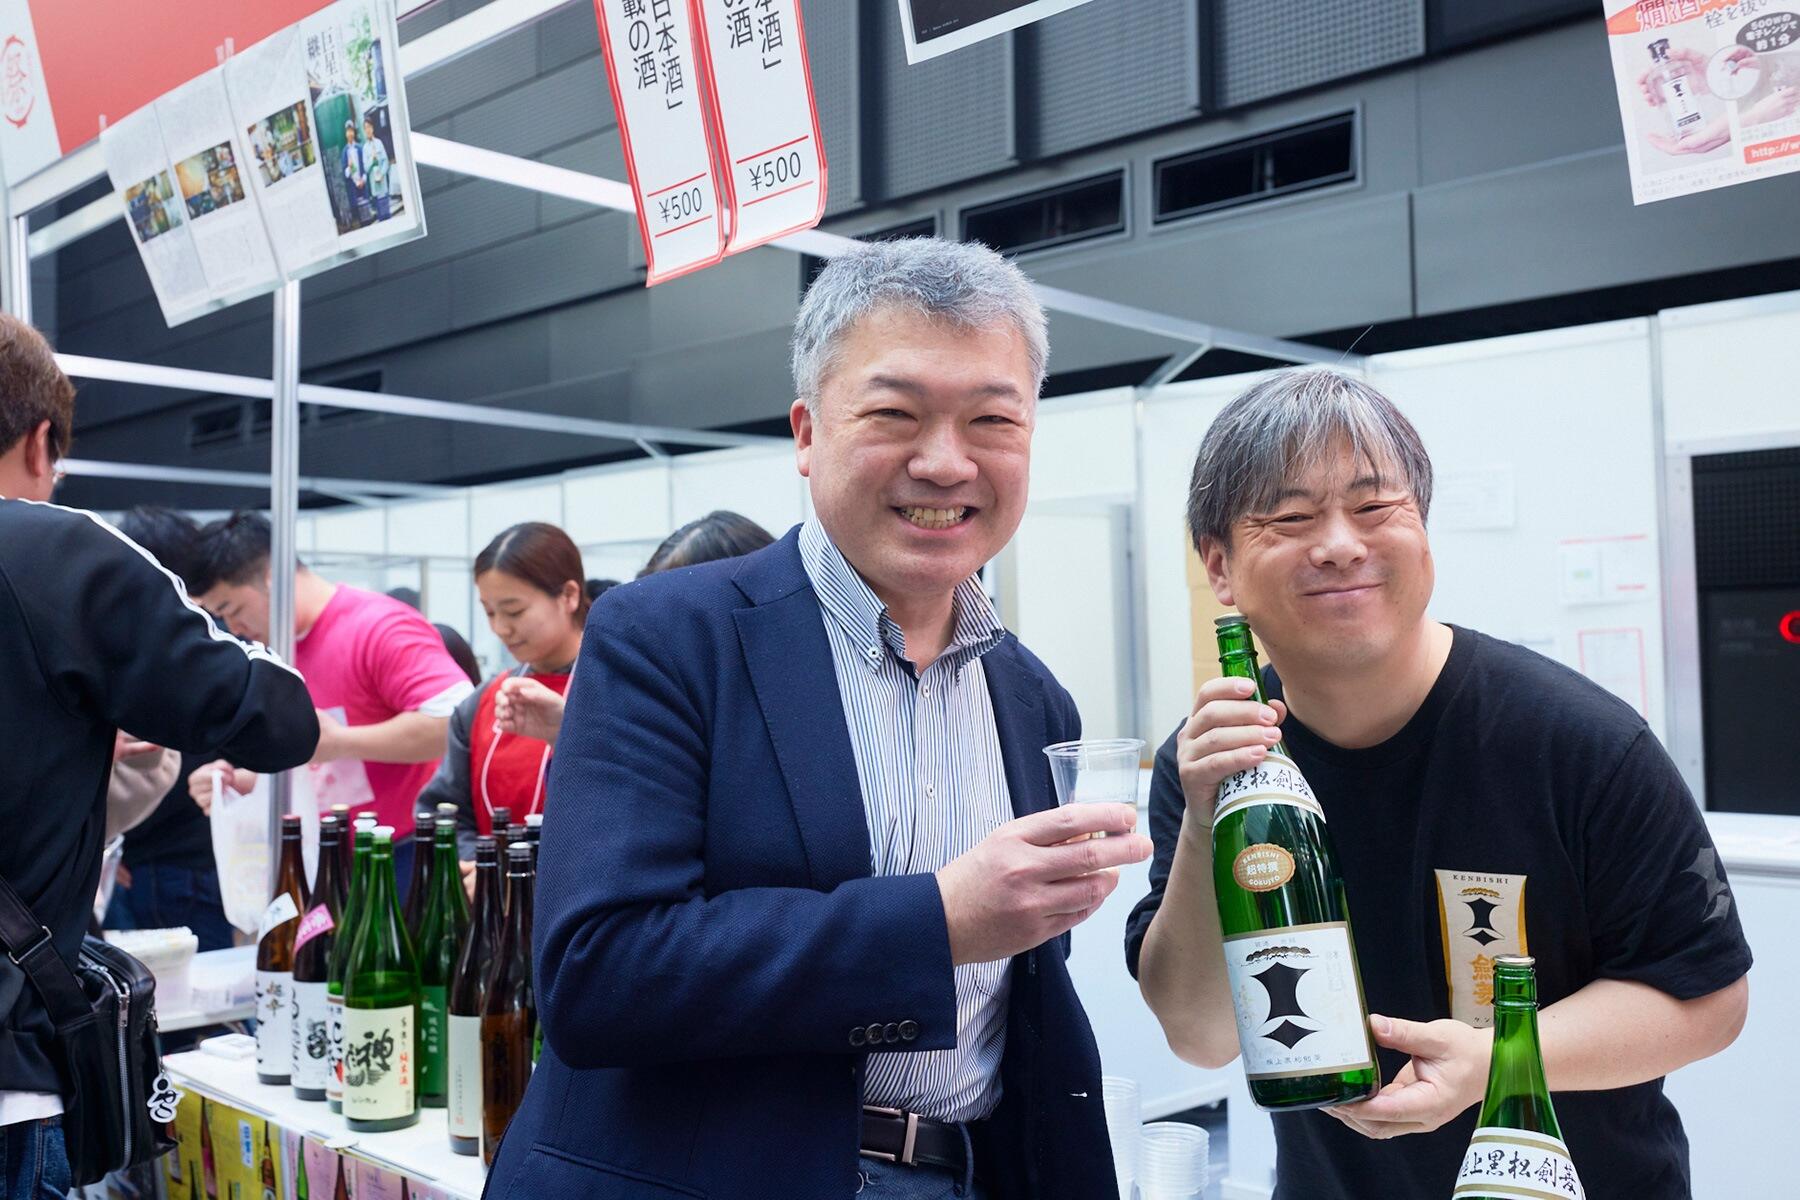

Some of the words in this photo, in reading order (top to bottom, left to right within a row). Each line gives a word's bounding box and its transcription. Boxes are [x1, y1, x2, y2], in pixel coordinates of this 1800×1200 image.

[749, 151, 802, 191] ¥500
[658, 187, 702, 224] ¥500
[1215, 766, 1312, 808] 上黒松剣菱
[1453, 874, 1509, 885] KENBISHI
